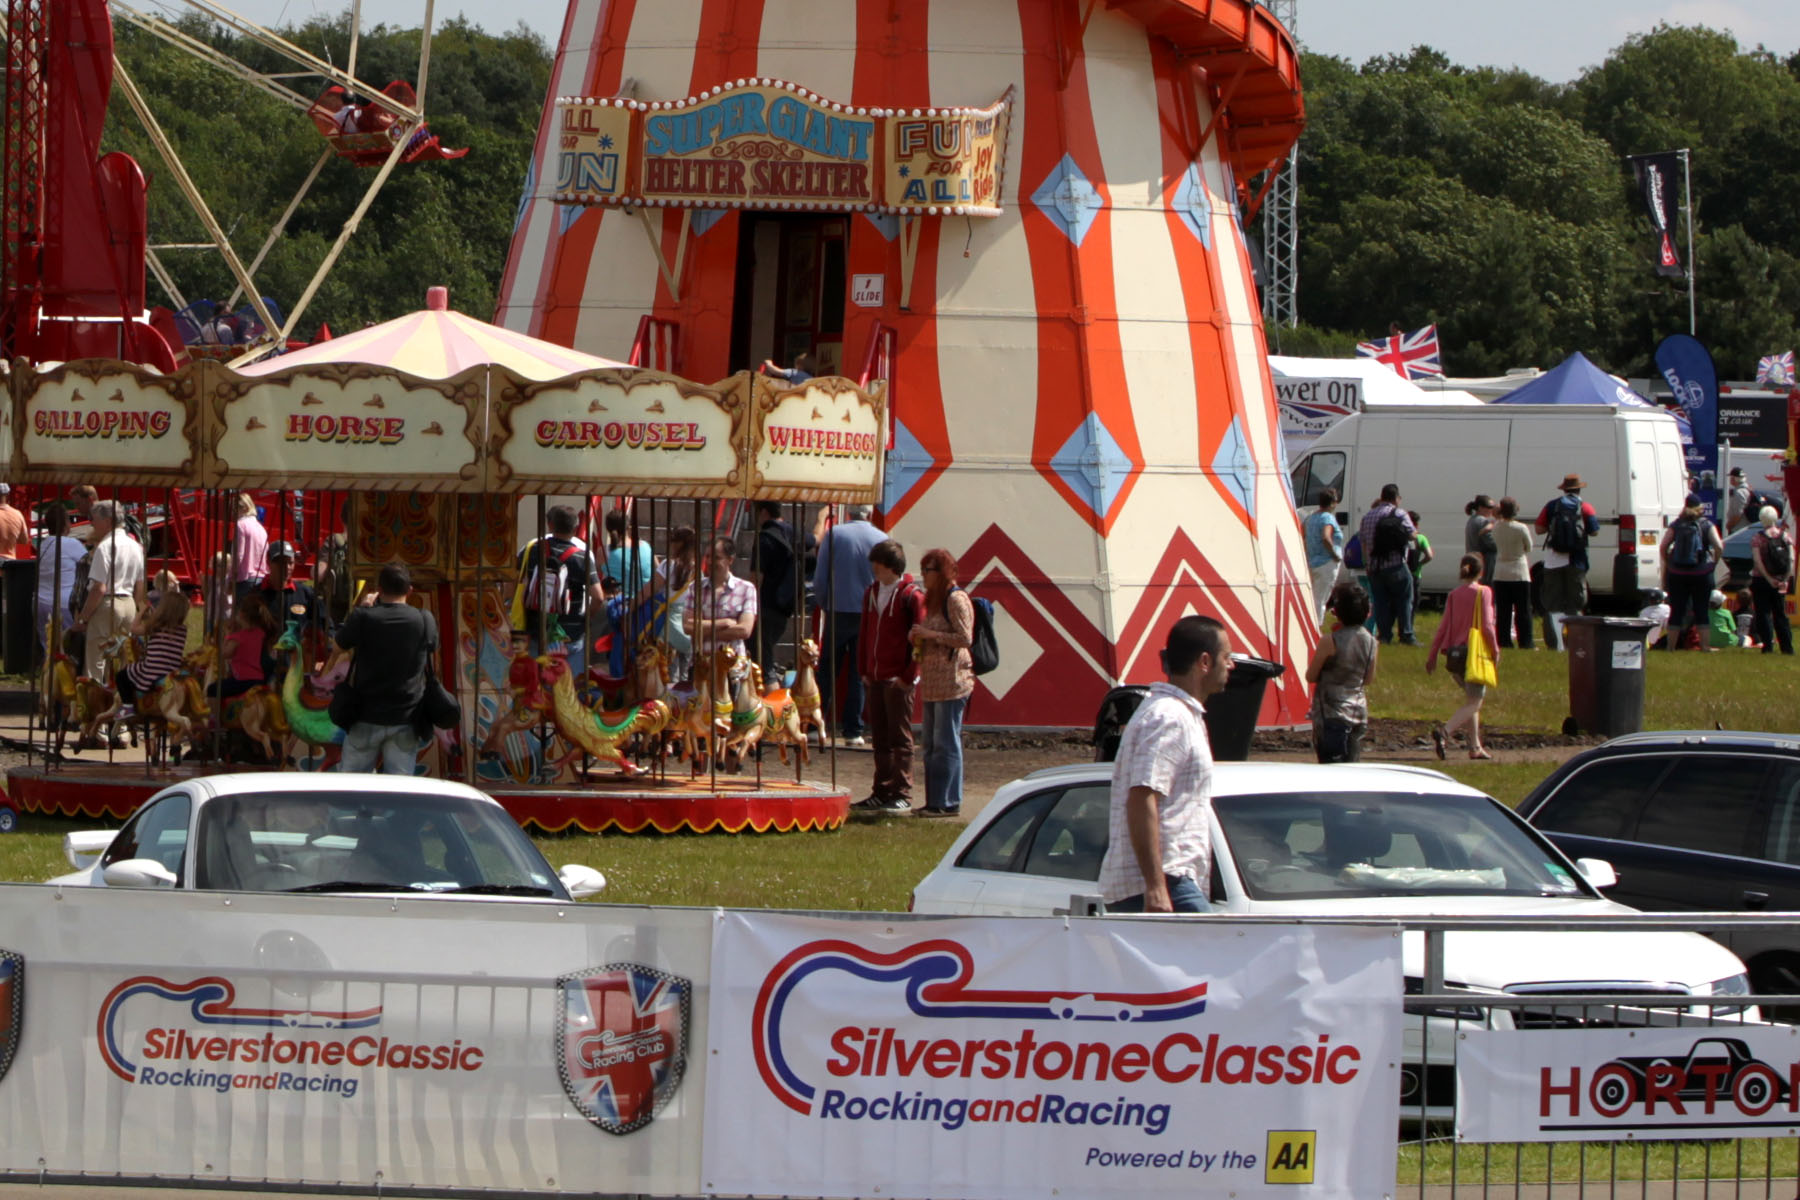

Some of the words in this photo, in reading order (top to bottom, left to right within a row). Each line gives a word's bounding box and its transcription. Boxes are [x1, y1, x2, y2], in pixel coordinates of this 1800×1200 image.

[561, 109, 599, 134] LL
[646, 92, 767, 155] SUPER
[768, 95, 874, 160] GIANT
[561, 135, 579, 149] OR
[556, 152, 619, 192] UN
[645, 158, 748, 195] HELTER
[751, 160, 871, 199] SKELTER
[925, 160, 963, 175] FOR
[902, 178, 971, 202] ALL
[855, 291, 881, 301] SLIDE
[1276, 381, 1321, 401] wer
[34, 410, 171, 439] GALLOPING
[285, 413, 405, 443] HORSE
[1719, 409, 1760, 417] ORMANCE
[534, 420, 707, 450] CAROUSEL
[767, 425, 876, 459] WHITELEGGS
[143, 1027, 485, 1071] SilverstoneClassic
[593, 1050, 635, 1069] Racing
[636, 1042, 664, 1057] Club
[826, 1026, 1361, 1085] SilverstoneClassic
[139, 1066, 358, 1098] RockingandRacing
[1539, 1063, 1800, 1118] HORTO
[820, 1090, 1171, 1135] RockingandRacing
[1085, 1147, 1184, 1169] Powered
[1187, 1150, 1217, 1173] by
[1221, 1150, 1257, 1169] the
[1272, 1142, 1309, 1170] AA
